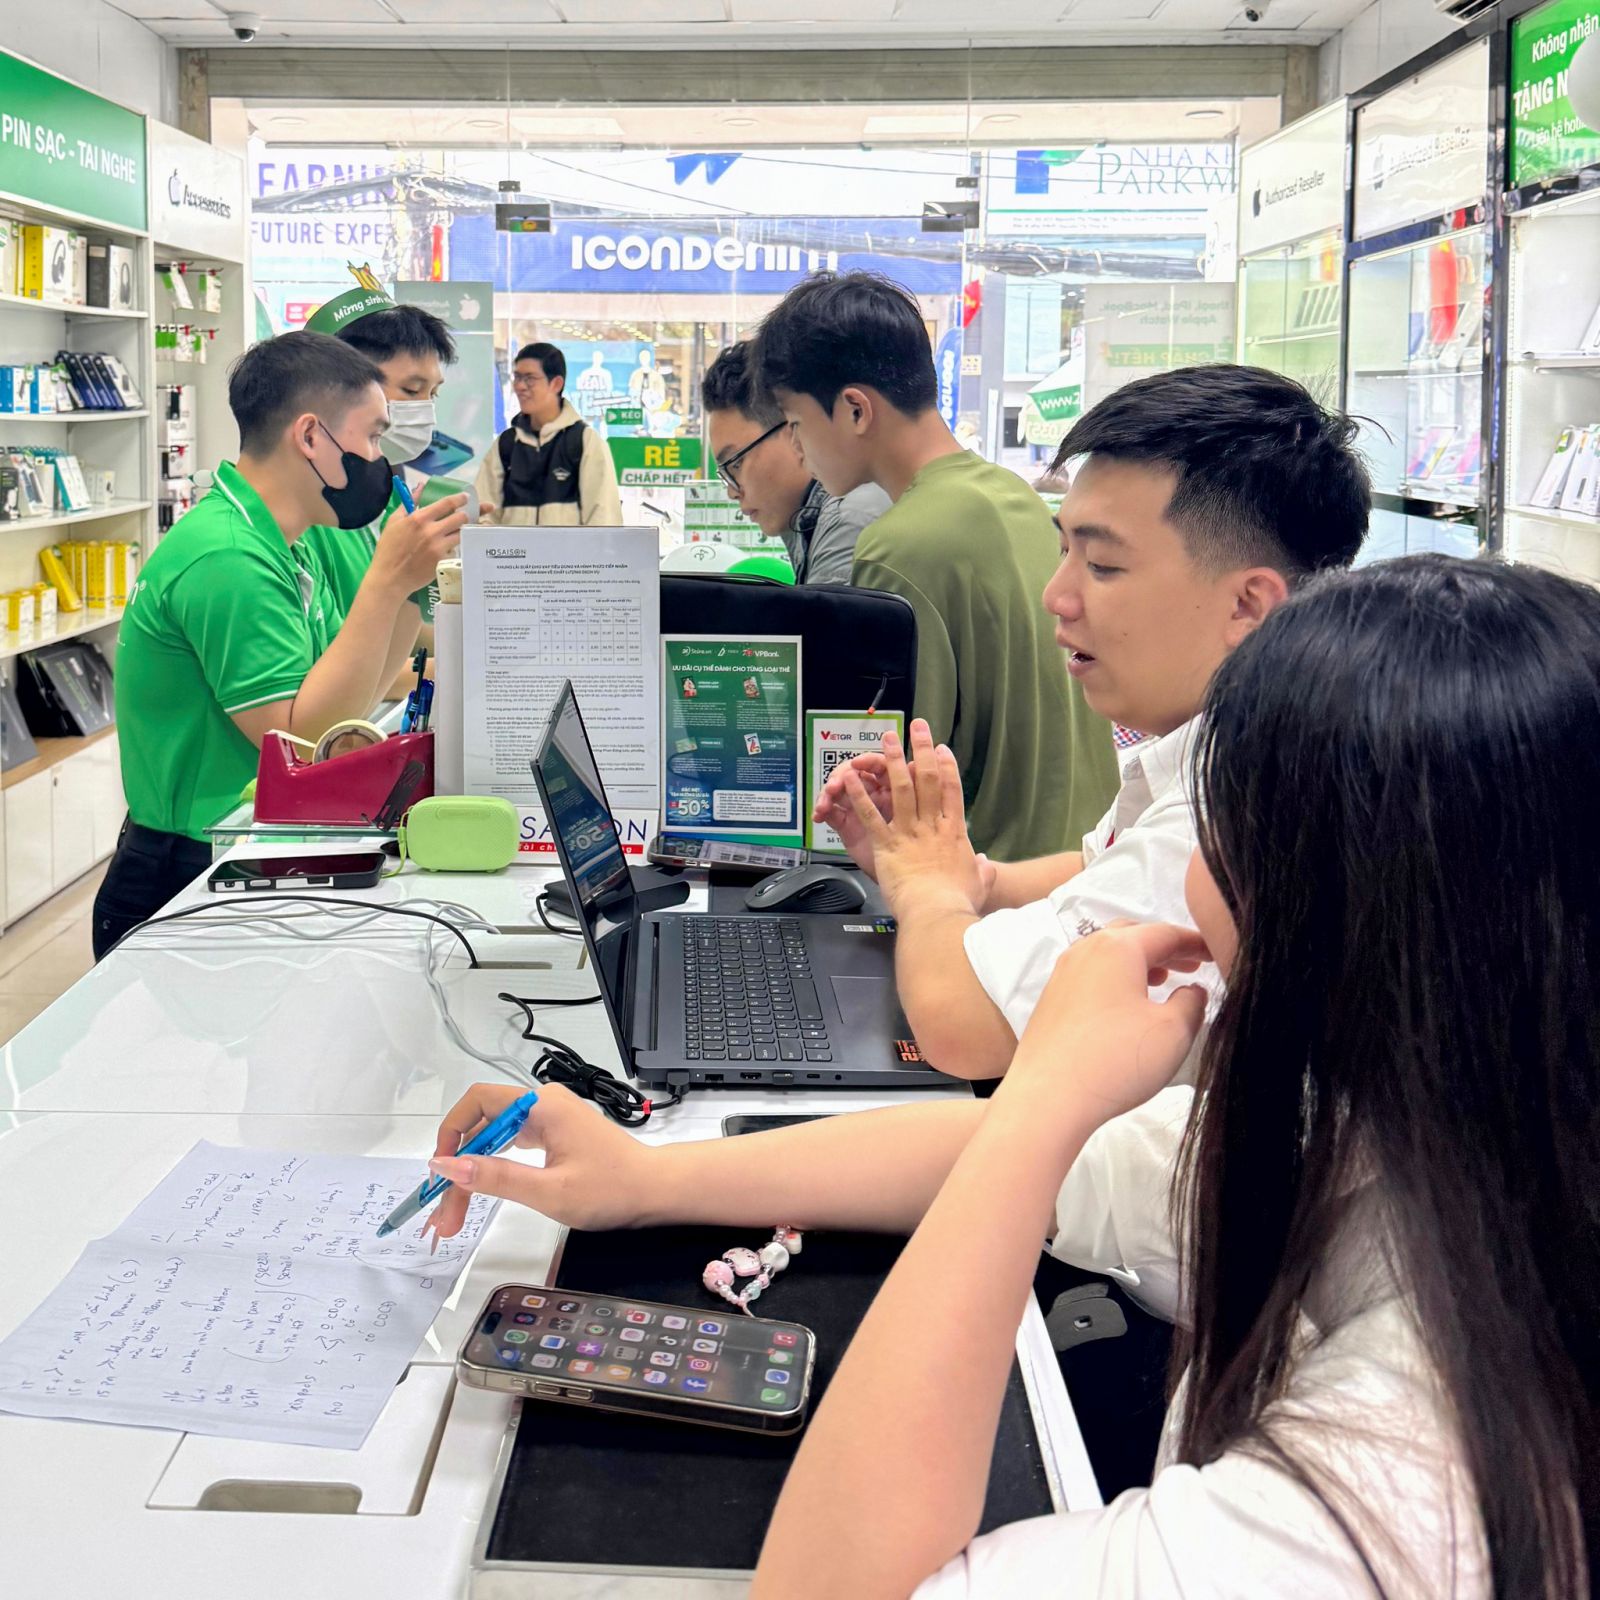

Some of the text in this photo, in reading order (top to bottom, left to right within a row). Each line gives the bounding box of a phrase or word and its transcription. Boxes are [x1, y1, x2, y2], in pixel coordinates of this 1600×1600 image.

[1532, 33, 1567, 63] Không
[1513, 68, 1569, 121] TẶNG N
[2, 113, 31, 150] PIN
[35, 125, 66, 164] SẠC
[77, 140, 98, 172] TAI
[101, 148, 136, 184] NGHE
[1094, 151, 1235, 195] PARKW
[335, 222, 393, 245] EXPE
[644, 438, 681, 467] RẺ
[625, 469, 693, 483] CHẤP HẾT!
[859, 731, 884, 741] BIDV
[678, 799, 710, 817] 50%
